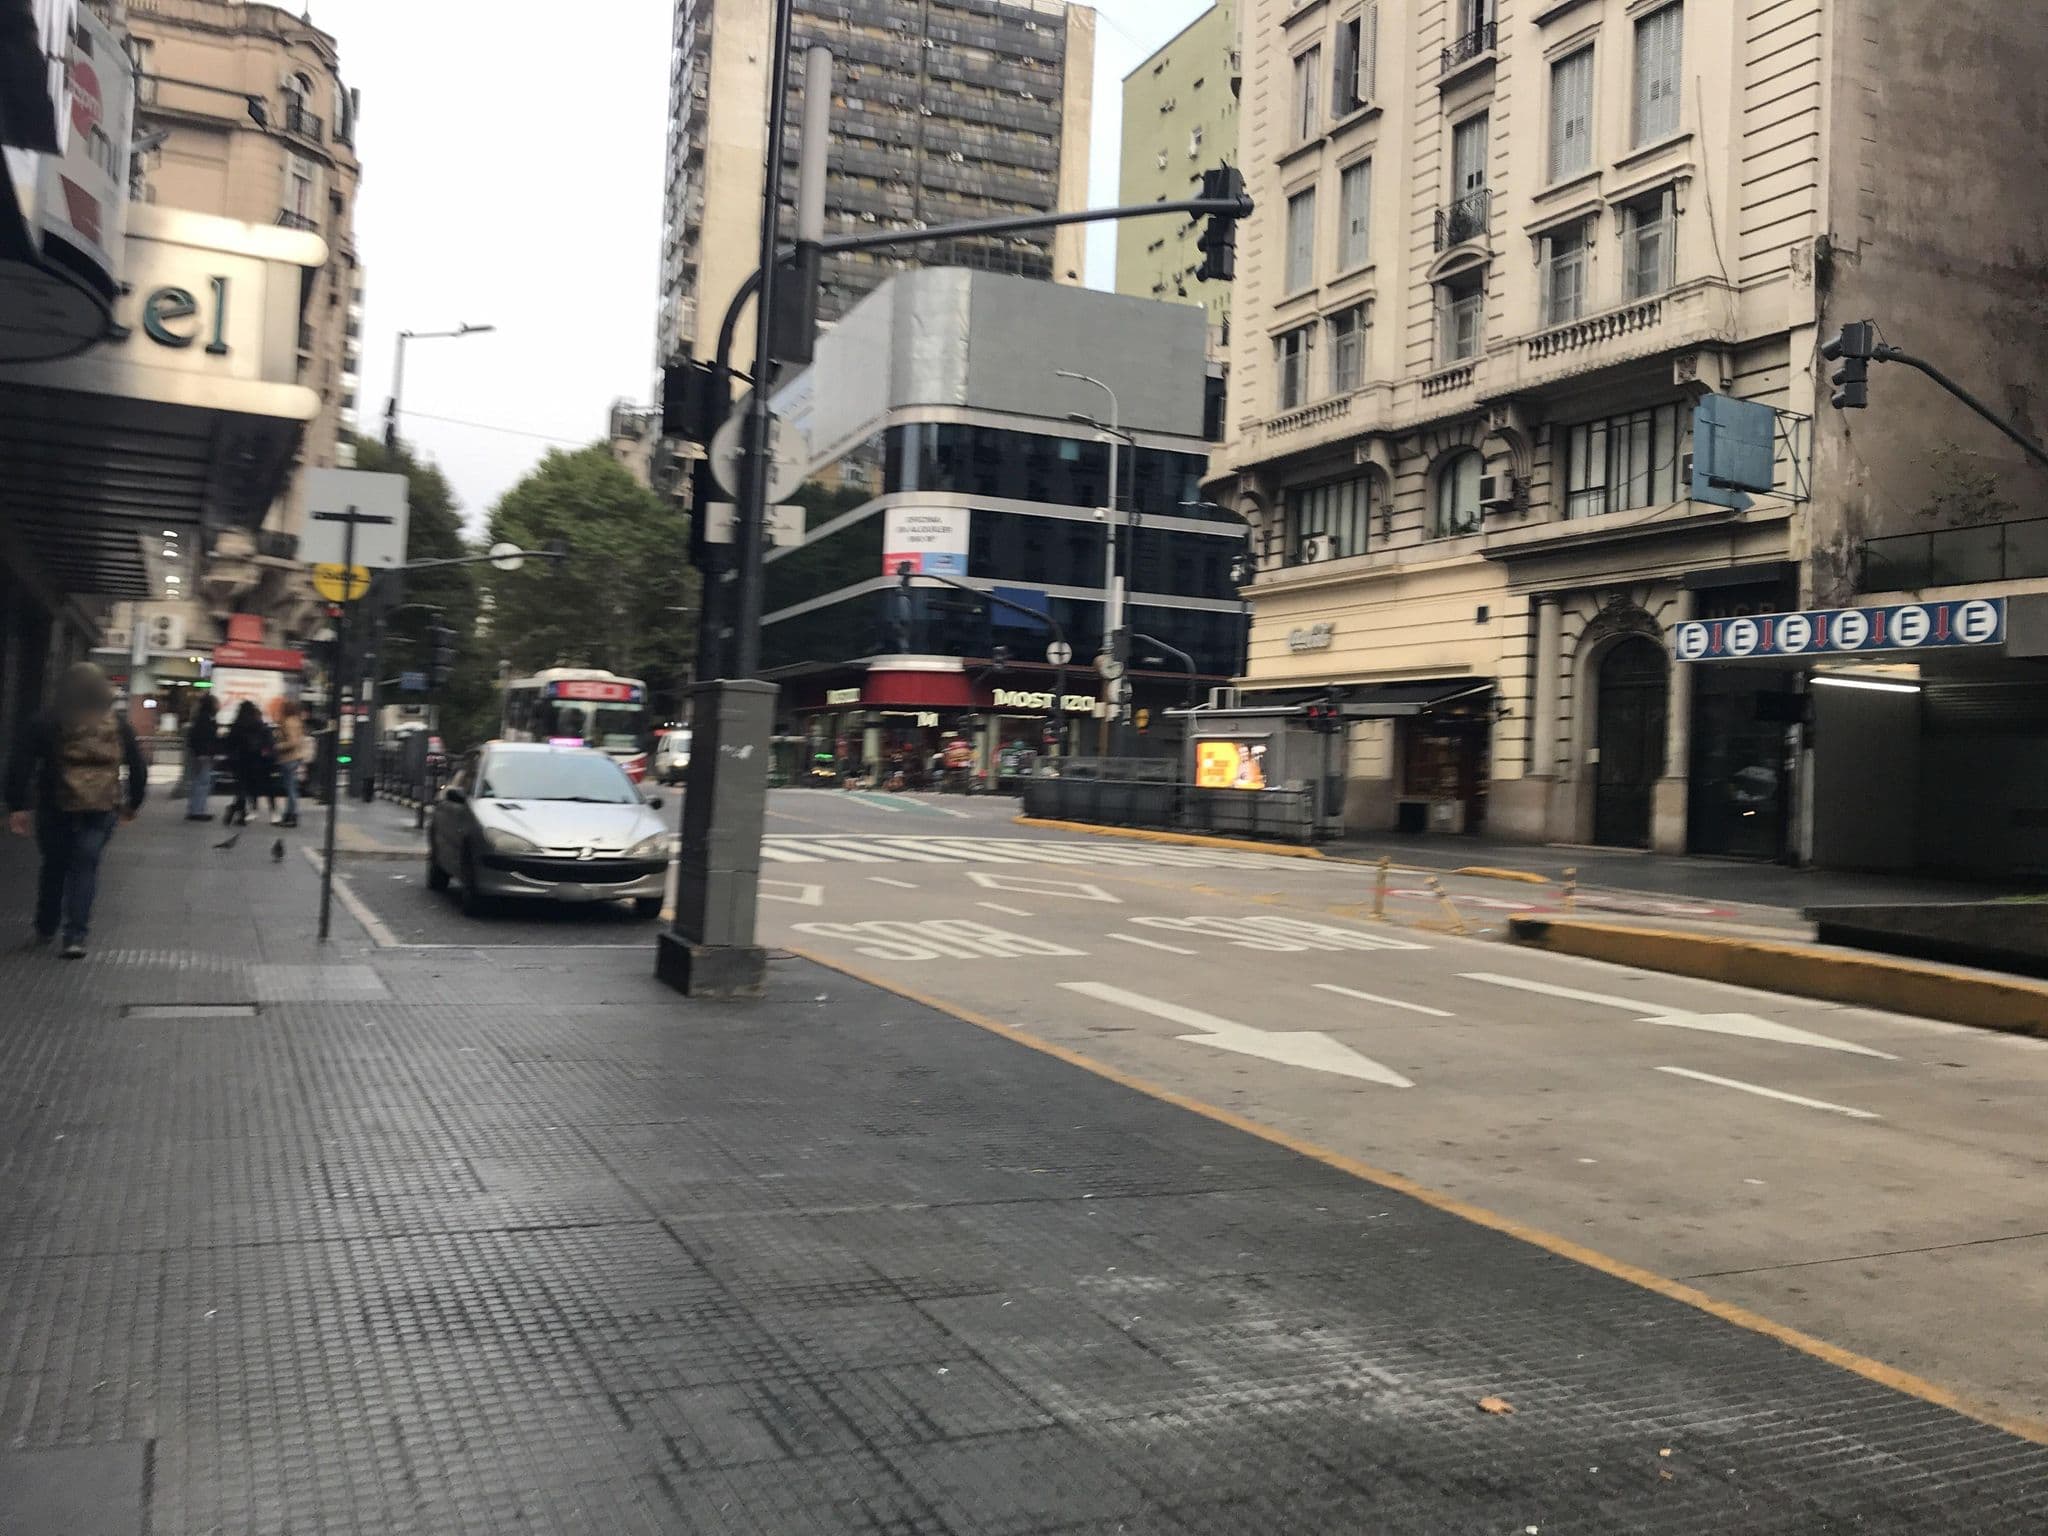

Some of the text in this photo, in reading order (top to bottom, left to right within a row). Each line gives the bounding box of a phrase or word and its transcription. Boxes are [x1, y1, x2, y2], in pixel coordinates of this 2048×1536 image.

[1686, 606, 1988, 653] E E E E E E
[789, 920, 1092, 961] BUS
[1127, 915, 1435, 952] BUS
